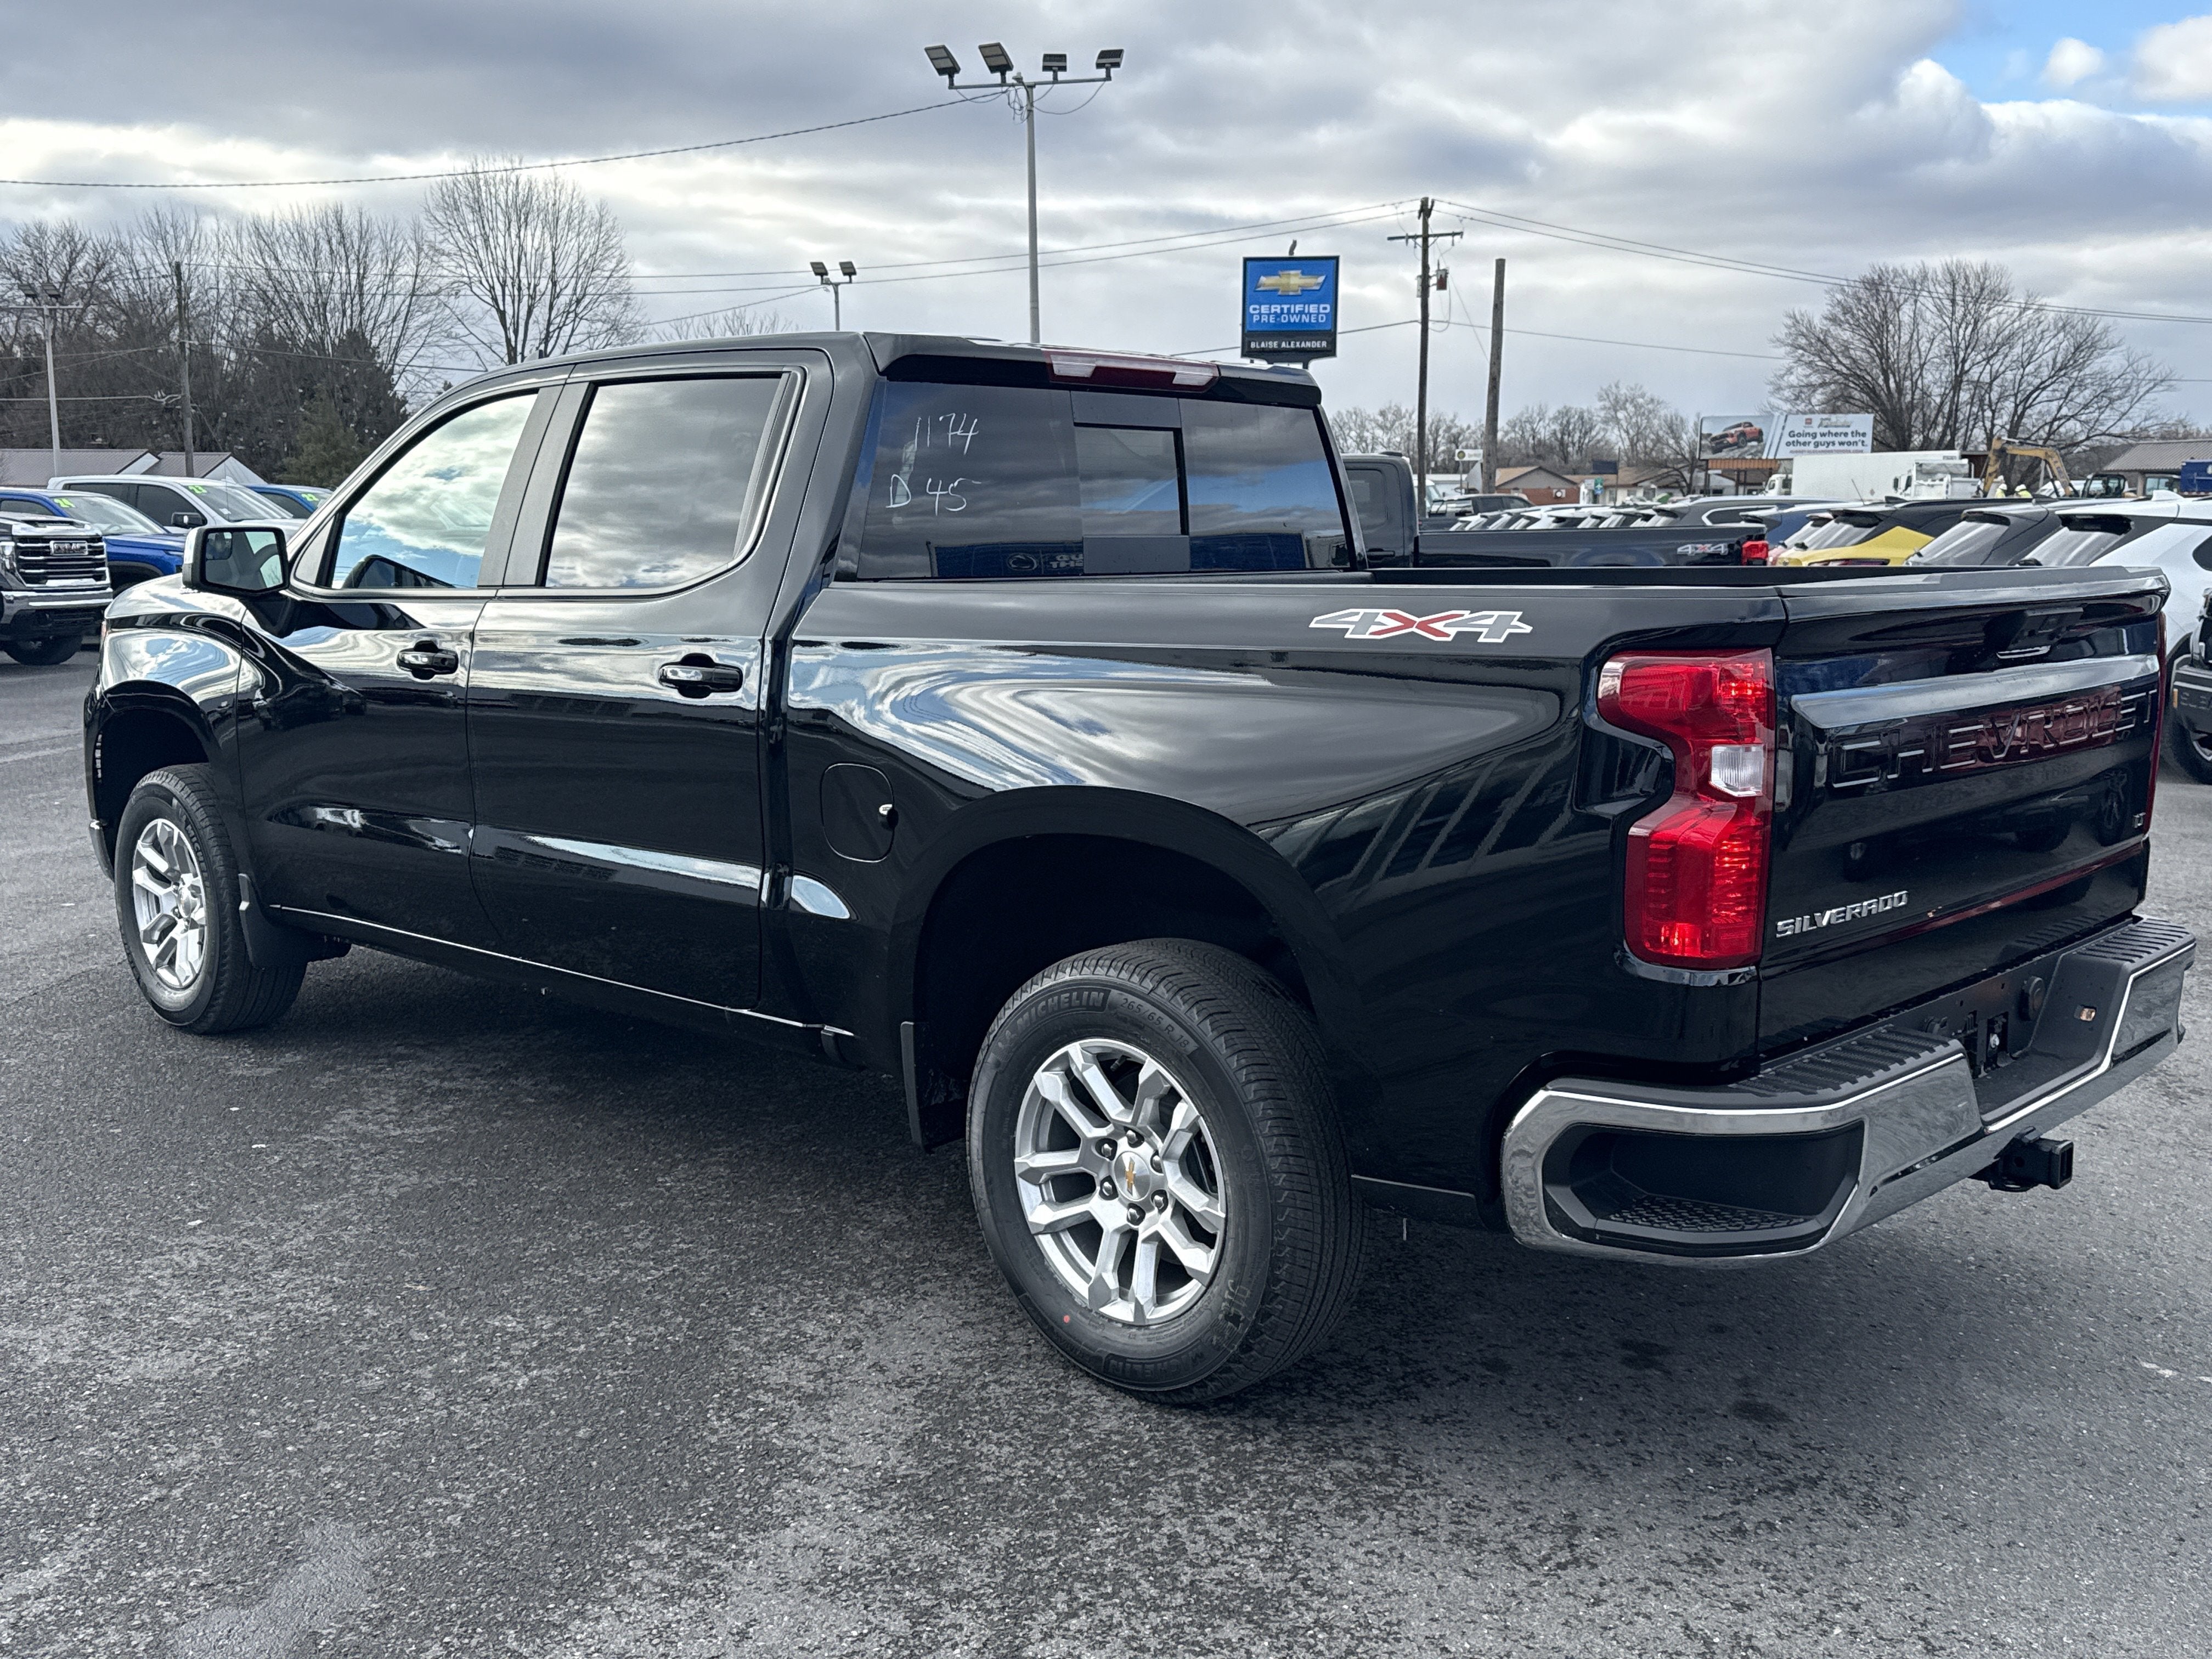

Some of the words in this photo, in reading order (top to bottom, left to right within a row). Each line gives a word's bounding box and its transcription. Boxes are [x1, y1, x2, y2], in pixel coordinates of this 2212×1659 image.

[1249, 304, 1330, 314] CERTIFIED
[1253, 314, 1327, 323] PRE-OWNED
[1250, 341, 1278, 349] BLAISE
[1281, 340, 1327, 348] ALEXANDER
[1788, 430, 1818, 439] Going
[1819, 430, 1849, 438] where
[1850, 430, 1867, 438] the
[1785, 439, 1812, 447] other
[1813, 440, 1836, 448] guys
[1838, 439, 1868, 447] won't.
[885, 473, 911, 508] D
[1831, 687, 2158, 788] CHEVROLET
[1776, 890, 1909, 938] SILVERADO
[1017, 991, 1105, 1030] MICHELIN
[1120, 997, 1164, 1026] 265/65
[1164, 1024, 1175, 1035] R
[1176, 1035, 1189, 1048] 18
